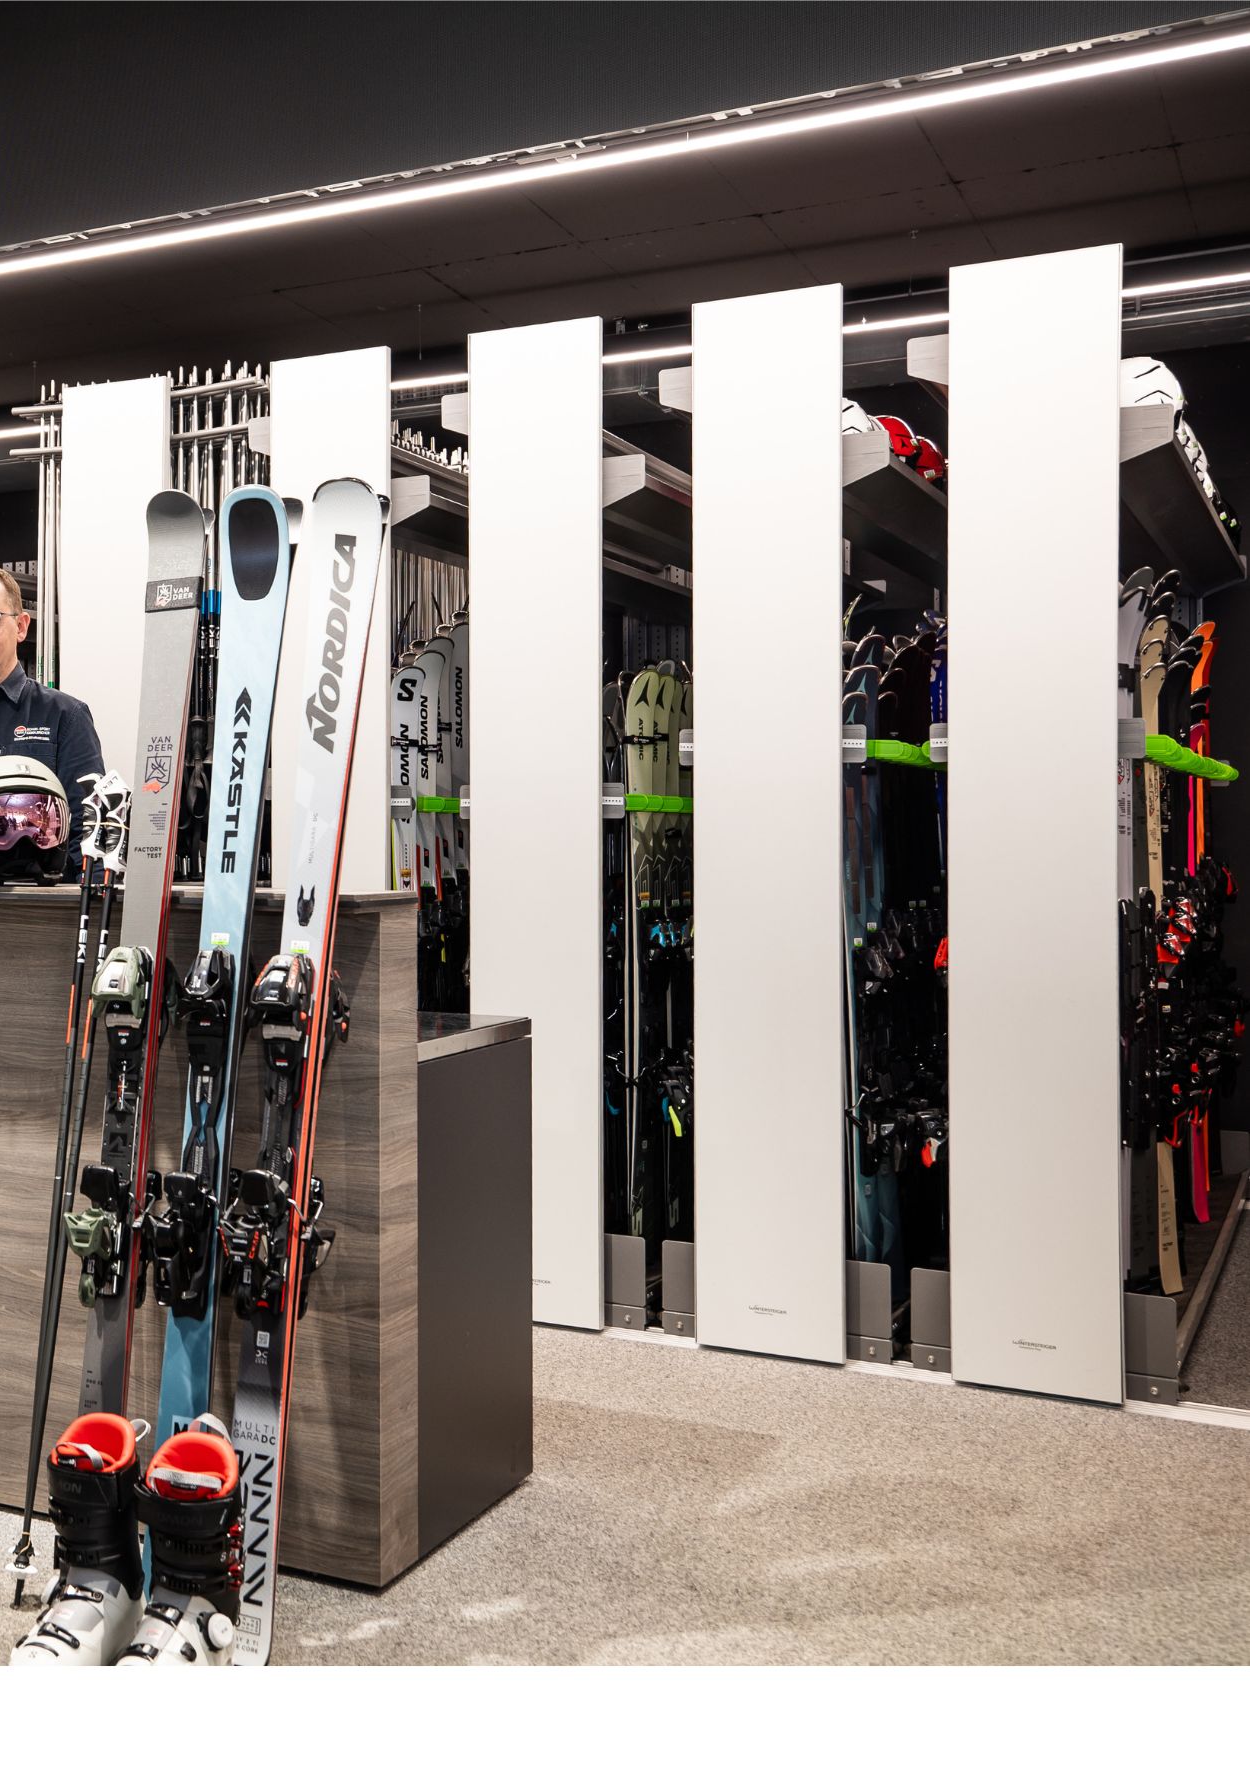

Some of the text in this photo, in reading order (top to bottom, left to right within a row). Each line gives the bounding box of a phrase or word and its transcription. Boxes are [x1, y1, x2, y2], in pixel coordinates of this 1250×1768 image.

[172, 592, 193, 601] DEER
[305, 534, 357, 754] NORDICA
[397, 678, 417, 702] S
[455, 667, 463, 749] SALOMON
[147, 744, 173, 752] DEER
[151, 736, 171, 744] VAN
[420, 695, 429, 780] SAOMON
[76, 914, 90, 964] LEKI
[95, 929, 109, 973] LEK
[234, 1419, 275, 1434] MULTI
